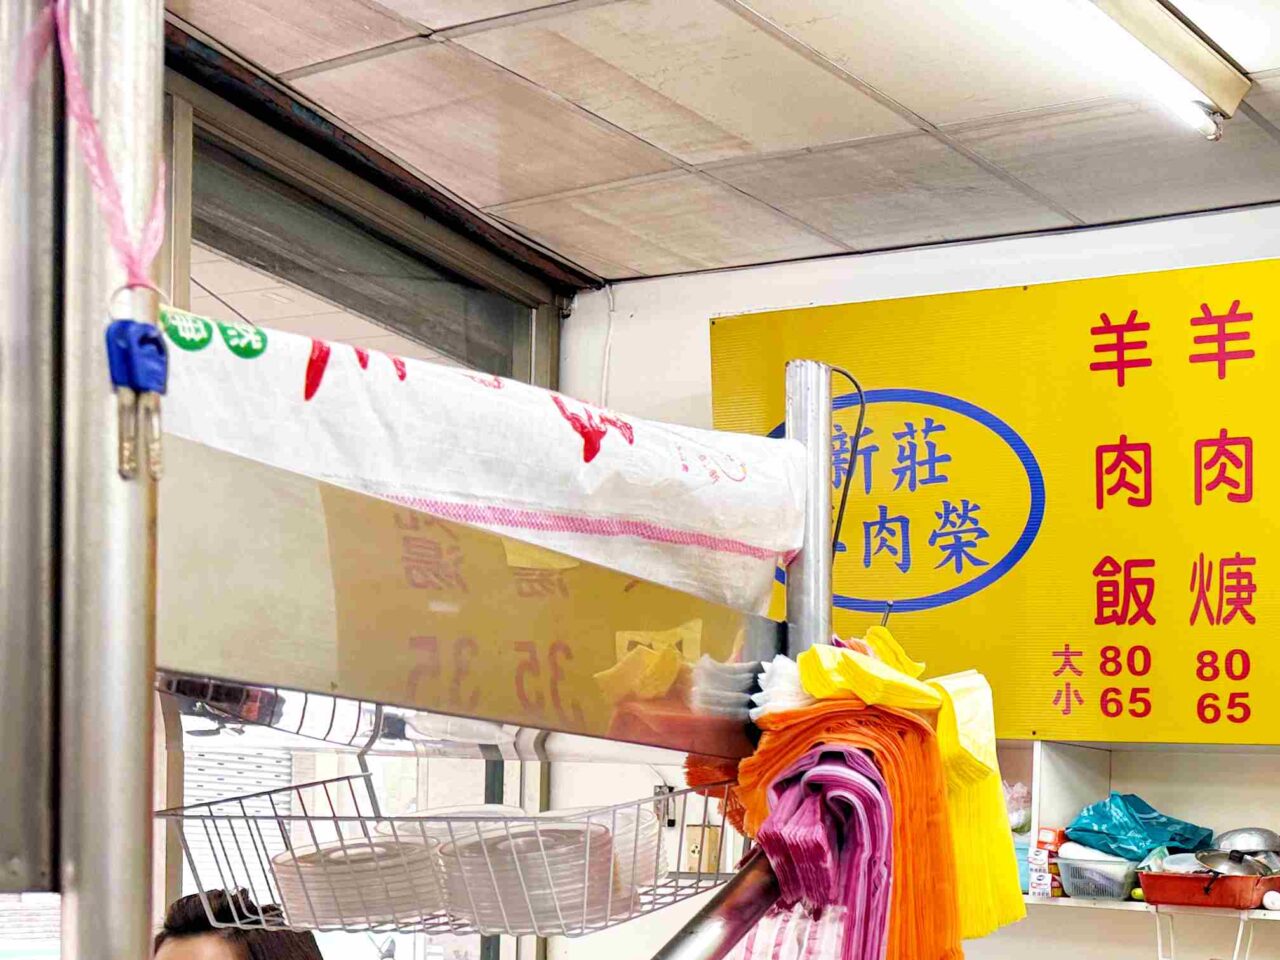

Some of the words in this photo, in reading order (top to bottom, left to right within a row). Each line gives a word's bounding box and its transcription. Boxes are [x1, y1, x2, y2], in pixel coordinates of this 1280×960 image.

[1091, 311, 1155, 624] 羊肉飯
[833, 500, 990, 574] 肉榮
[1055, 648, 1081, 674] 大
[1101, 646, 1150, 676] 80
[1197, 650, 1249, 680] 80
[1054, 684, 1082, 714] 小
[1101, 688, 1150, 717] 65
[1198, 693, 1250, 723] 65
